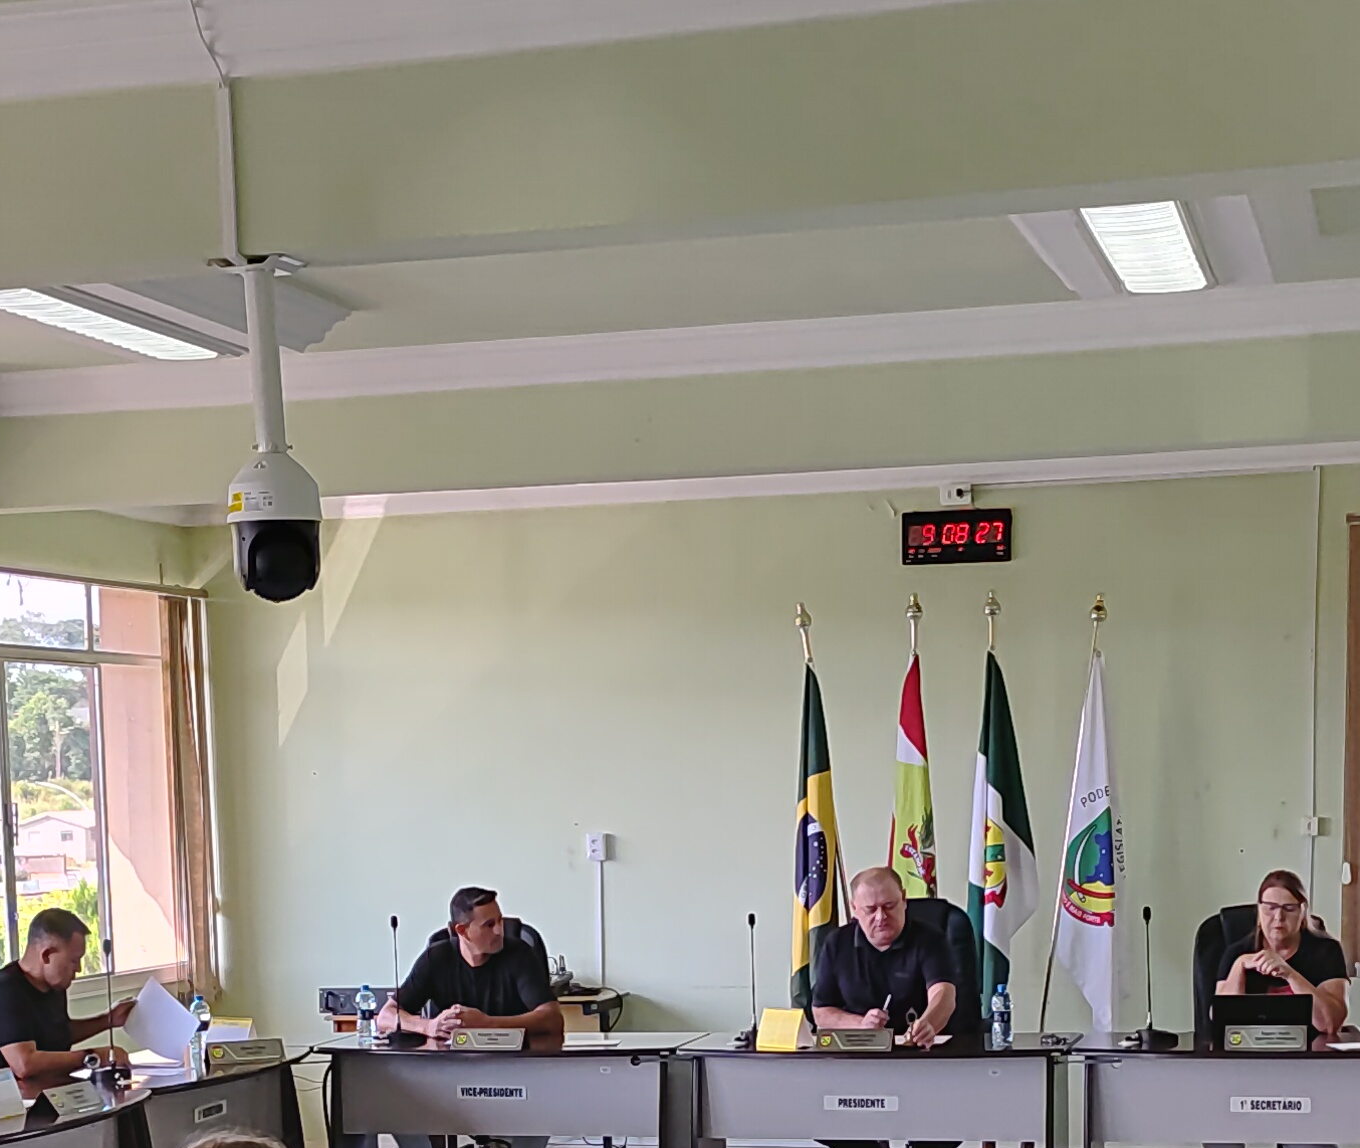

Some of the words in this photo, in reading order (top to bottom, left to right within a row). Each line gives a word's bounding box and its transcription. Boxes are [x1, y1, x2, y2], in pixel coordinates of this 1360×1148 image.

[1080, 785, 1111, 808] PODE
[460, 1087, 524, 1099] VICE-PRESIDENTE
[837, 1098, 886, 1109] PRESIDENTE
